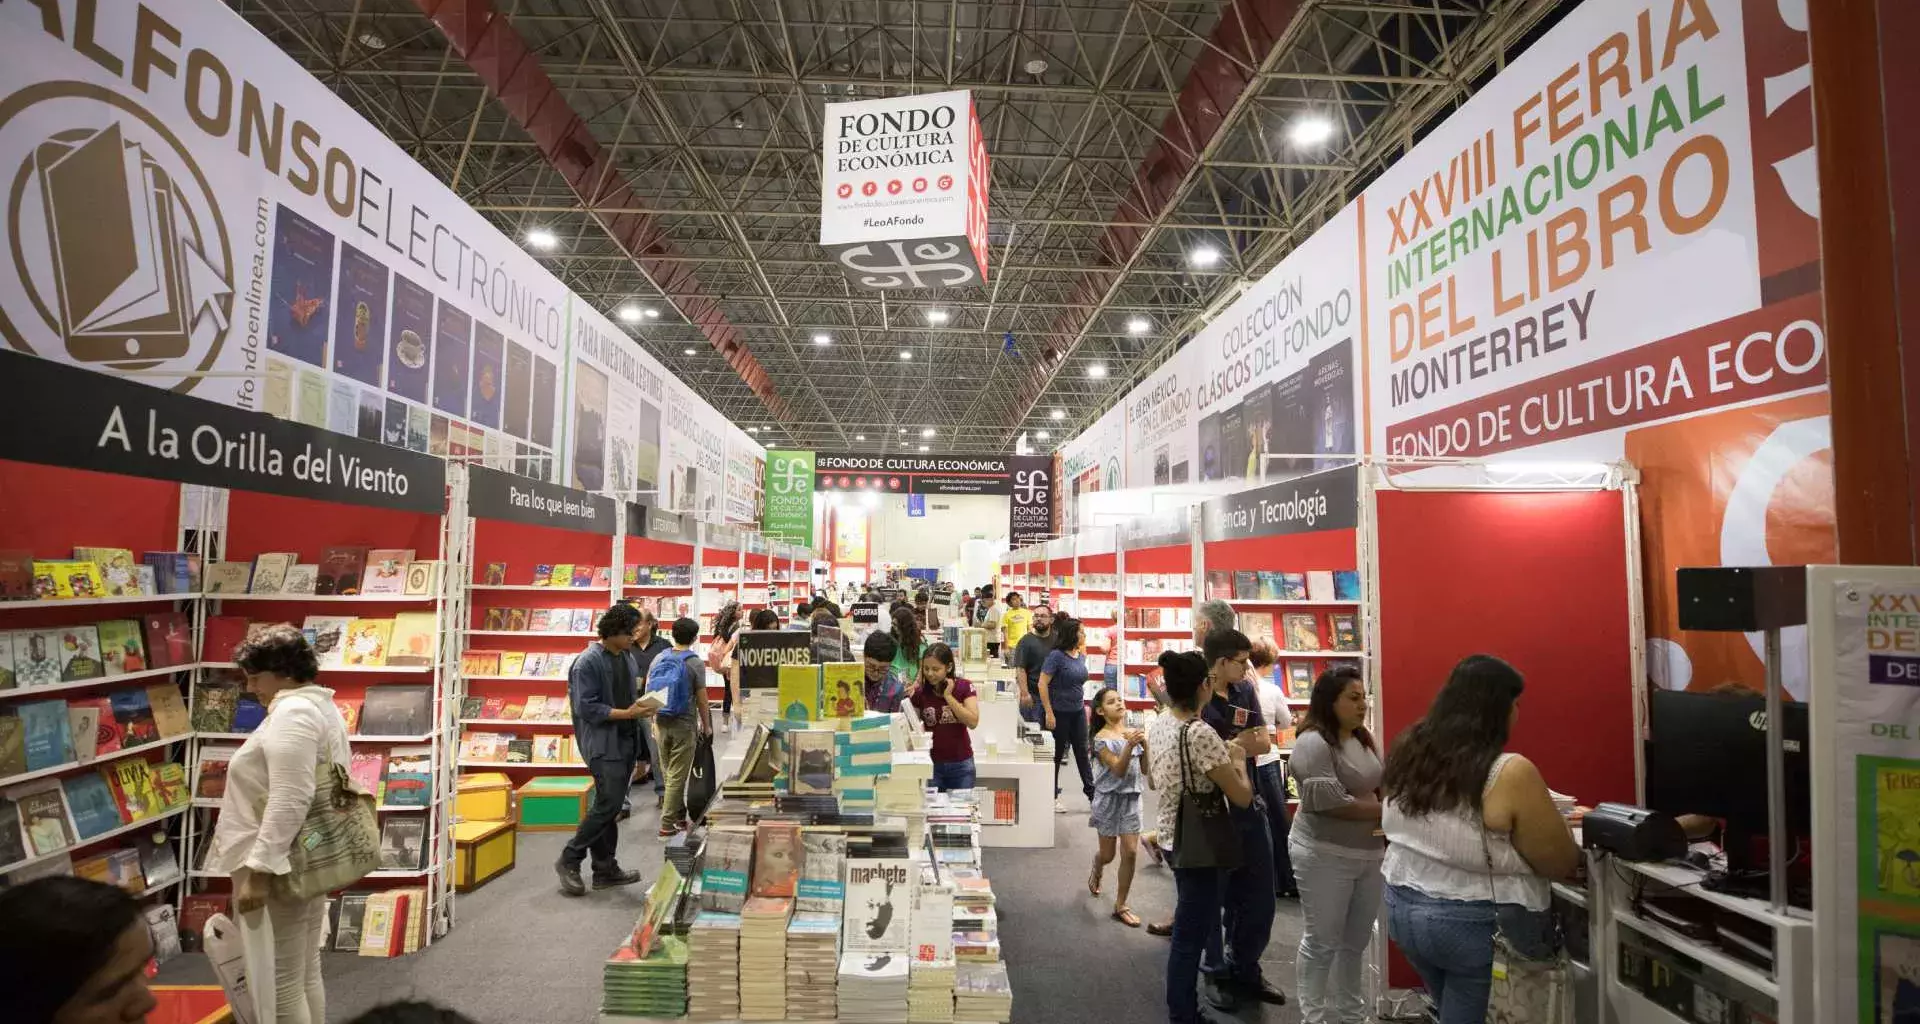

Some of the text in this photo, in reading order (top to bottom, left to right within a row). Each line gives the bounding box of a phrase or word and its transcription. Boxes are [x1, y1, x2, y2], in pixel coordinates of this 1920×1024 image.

[840, 105, 956, 138] FONDO
[1386, 0, 1720, 255] XXVIII FERIA
[839, 131, 954, 154] DE CULTURA
[837, 149, 954, 172] ECONÓMICA
[1388, 64, 1725, 299] INTERNACIONAL
[863, 214, 924, 228] #LeoAFondo
[1389, 135, 1730, 363] DEL LIBRO
[1222, 276, 1304, 360] COLECCIÓN
[577, 316, 598, 361] PARA
[1198, 353, 1252, 410] CLÁSICOS
[1254, 339, 1281, 377] DEL
[1283, 288, 1352, 359] FONDO
[1391, 290, 1597, 408] MONTERREY
[1151, 374, 1177, 405] MÉXICO
[1393, 319, 1826, 463] FONDO DE CULTURA ECO
[98, 405, 409, 496] A la Orilla del Viento
[827, 457, 868, 468] FONDO
[869, 458, 884, 469] DE
[887, 459, 936, 470] CULTURA
[938, 459, 1006, 471] ECONÓMICA
[509, 486, 595, 520] Para los que leen bien
[771, 495, 808, 505] FONDO
[1013, 507, 1048, 515] FONDO
[1216, 502, 1247, 533] Cencia
[1249, 507, 1258, 533] y
[1260, 488, 1327, 527] Tecnología
[853, 608, 878, 616] OFERTAS
[739, 647, 811, 667] NOVEDADES
[1886, 662, 1920, 680] DE
[850, 863, 907, 885] machete
